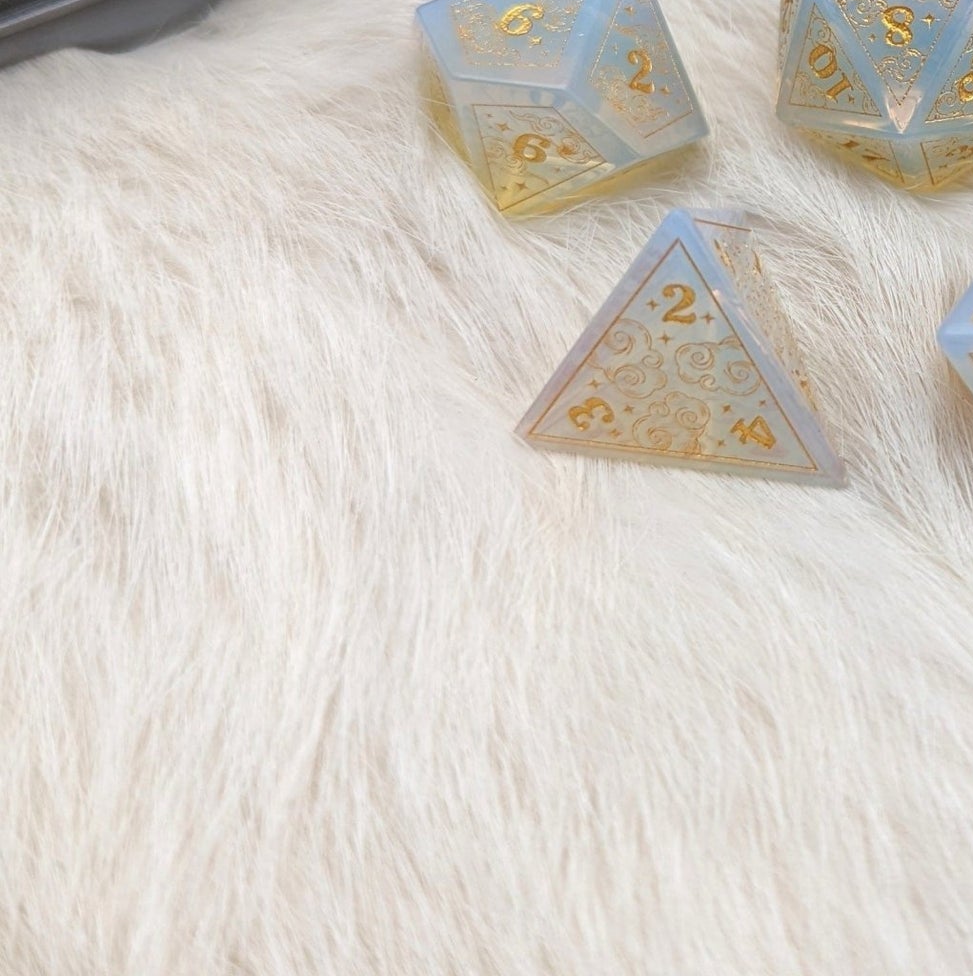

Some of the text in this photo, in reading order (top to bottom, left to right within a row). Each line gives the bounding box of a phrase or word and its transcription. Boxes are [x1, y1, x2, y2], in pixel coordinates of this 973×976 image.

[881, 5, 915, 47] 8
[627, 50, 655, 94] 2
[808, 44, 854, 103] 10
[661, 284, 697, 325] 2
[567, 396, 615, 431] 3
[730, 415, 777, 450] 4
